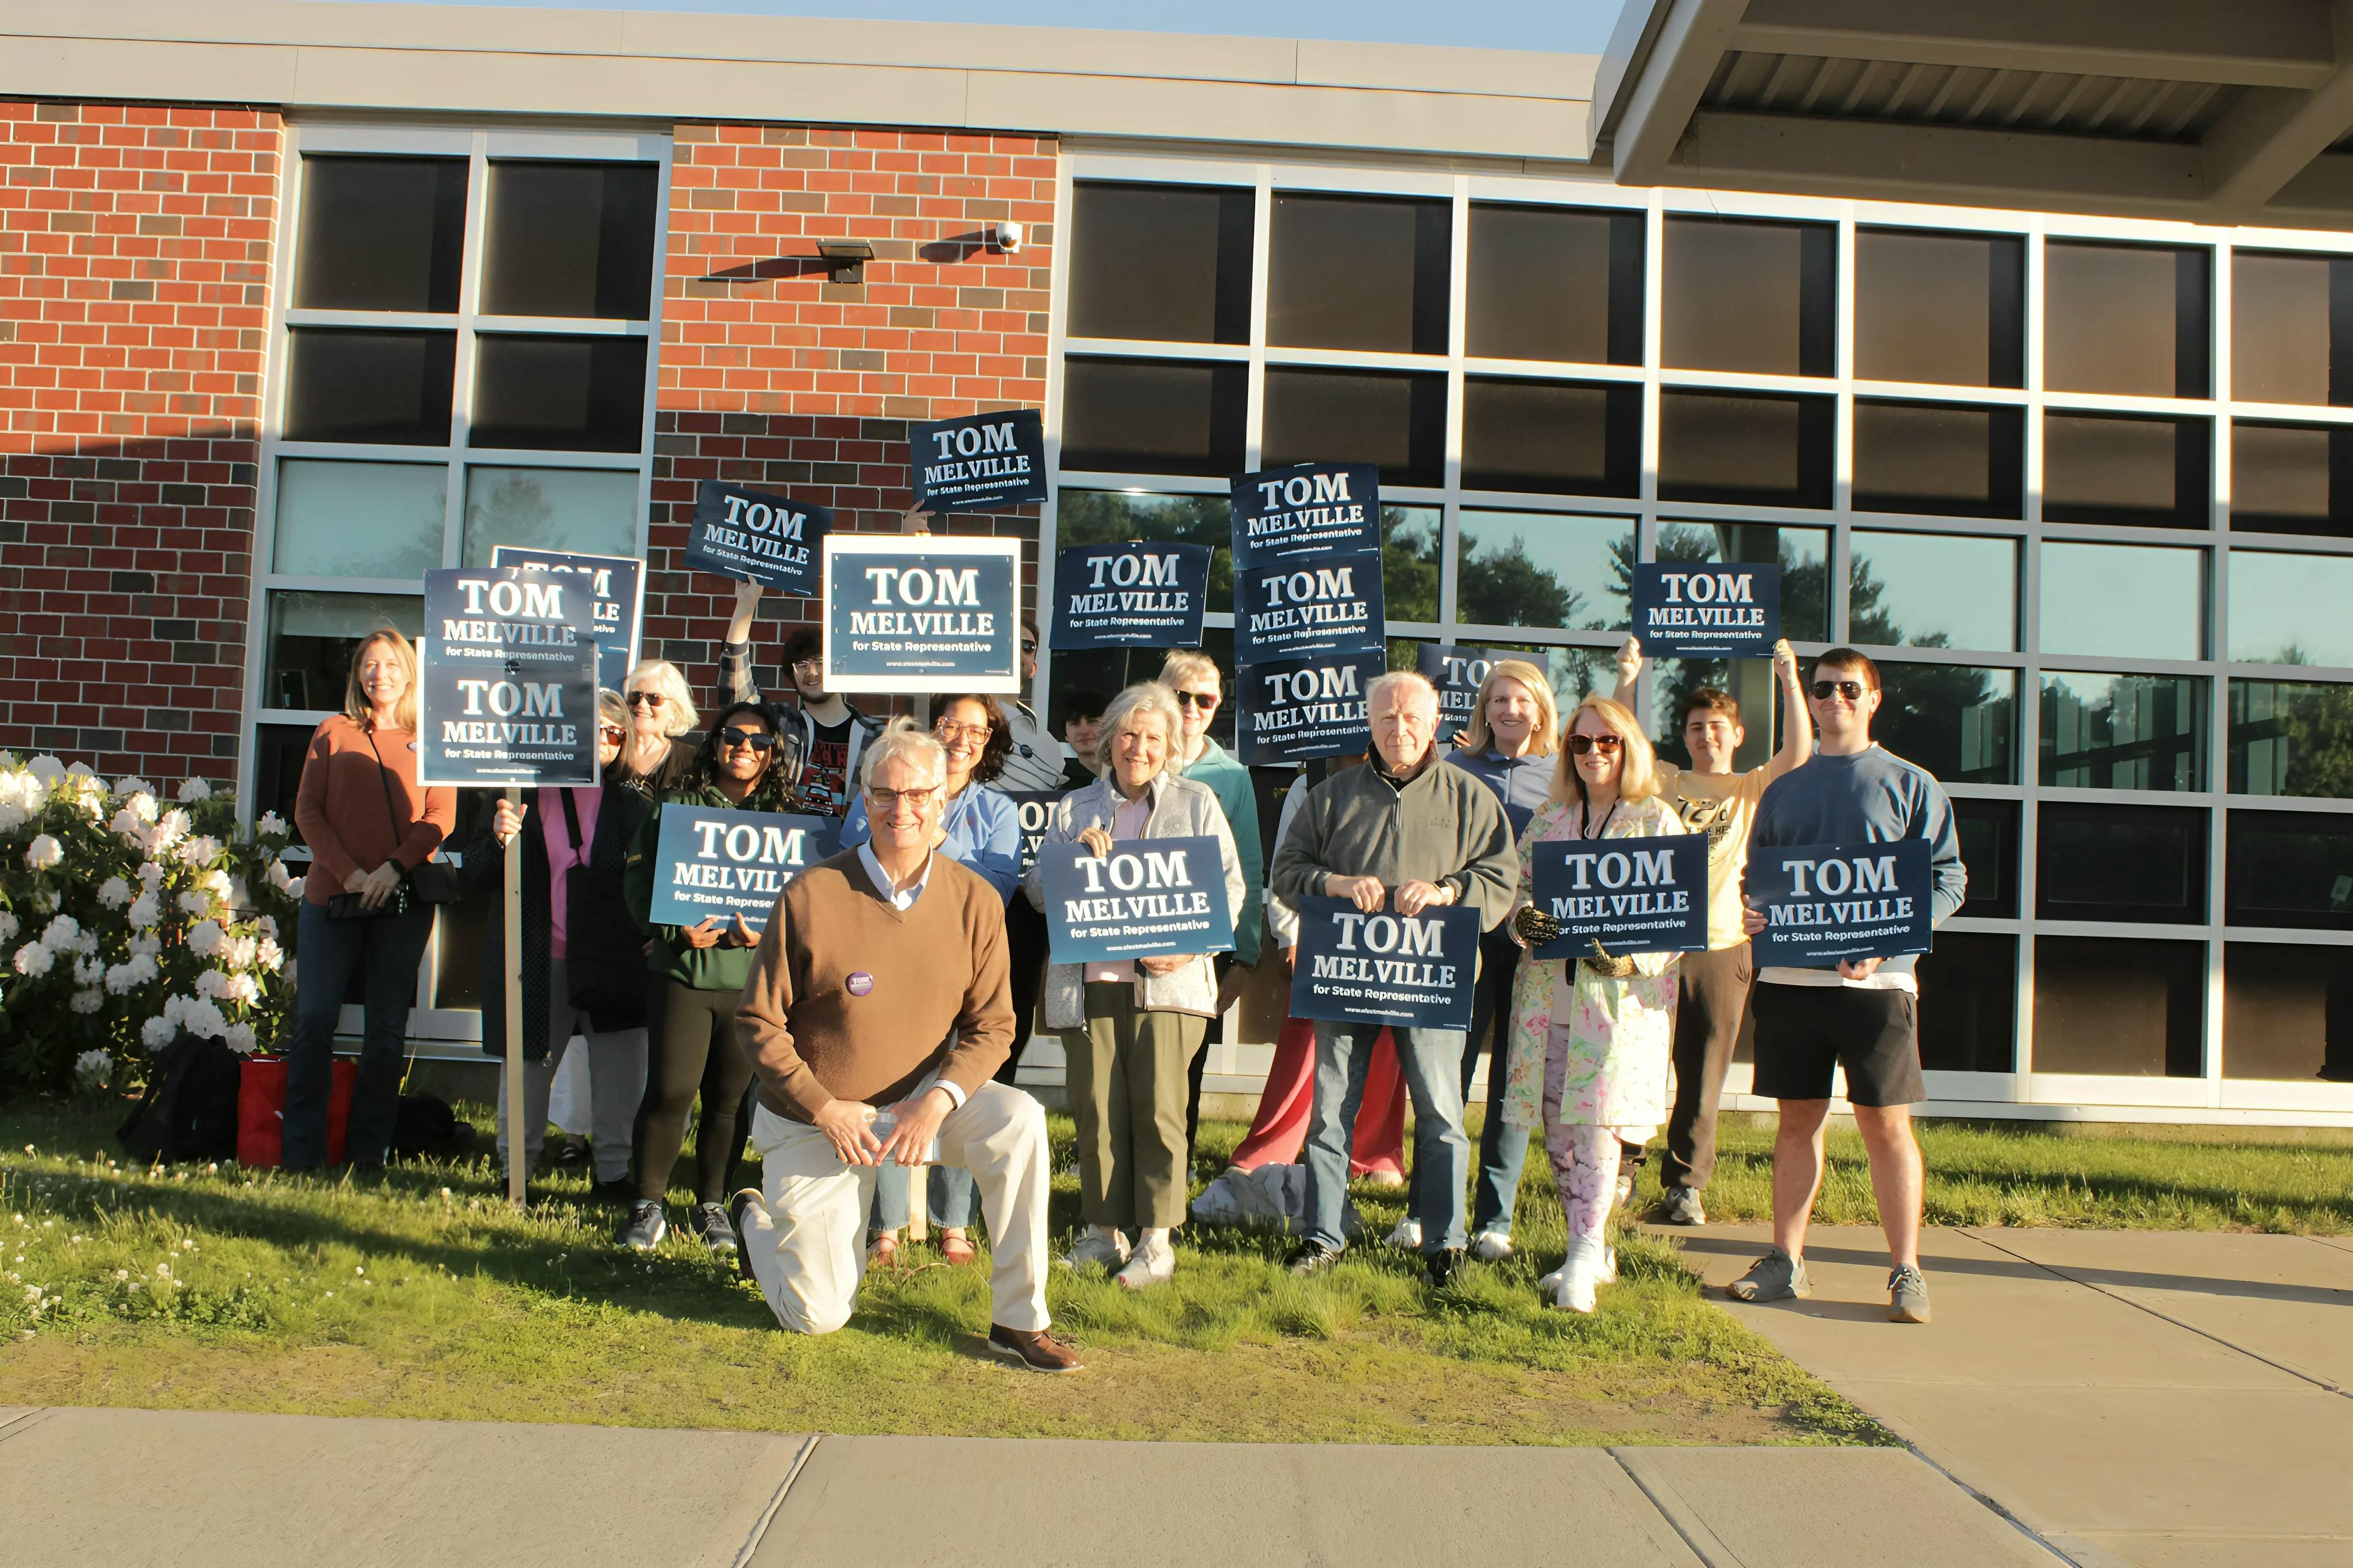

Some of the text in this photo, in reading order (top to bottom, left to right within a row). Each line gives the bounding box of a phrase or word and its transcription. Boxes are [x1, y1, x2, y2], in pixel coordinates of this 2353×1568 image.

[933, 423, 1017, 459] TOM
[924, 455, 1031, 484] MELVILLE
[940, 486, 962, 495] State
[965, 477, 1029, 492] Representative
[1259, 473, 1351, 511] TOM
[724, 495, 806, 542] TOM
[1248, 505, 1364, 536] MELVILLE
[703, 524, 809, 565] MELVILLE
[1251, 528, 1362, 549] for State Representative
[703, 545, 715, 554] for
[716, 549, 739, 561] State
[740, 555, 803, 576] Representative
[1087, 554, 1179, 588] TOM
[458, 580, 564, 619] TOM
[866, 568, 979, 605] TOM
[1262, 567, 1355, 607] TOM
[1661, 574, 1753, 603] TOM
[1069, 592, 1188, 613] MELVILLE
[1250, 602, 1368, 632] MELVILLE
[1648, 608, 1764, 625] MELVILLE
[443, 620, 577, 646] MELVILLE
[850, 612, 994, 635] MELVILLE
[1070, 616, 1184, 627] for State Representative
[1252, 625, 1366, 644] for State Representative
[1650, 630, 1662, 638] for
[1692, 631, 1762, 640] Representative
[446, 646, 574, 661] for State Representative
[853, 641, 991, 652] for State Representative
[1265, 666, 1359, 705] TOM
[1442, 656, 1491, 688] TO
[458, 680, 564, 717] TOM
[442, 721, 577, 745] MELVILLE
[1257, 736, 1269, 744] for
[1272, 733, 1295, 743] State
[445, 748, 574, 760] for State Representative
[694, 821, 805, 864] TOM
[673, 863, 794, 892] MELVIL
[1075, 851, 1192, 892] TOM
[1565, 849, 1676, 889] TOM
[1783, 856, 1899, 896] TOM
[674, 890, 774, 908] for State Represe
[1064, 892, 1210, 922] MELVILLE
[1551, 891, 1689, 919] MELVILLE
[1769, 897, 1914, 926] MELVILLE
[1071, 920, 1210, 938] for State Representative
[1333, 913, 1445, 957] TOM
[1559, 918, 1686, 934] or State Representative
[1772, 925, 1911, 942] for State Representative
[1312, 955, 1456, 988] MELVILLE
[1313, 984, 1451, 1005] for State Representative
